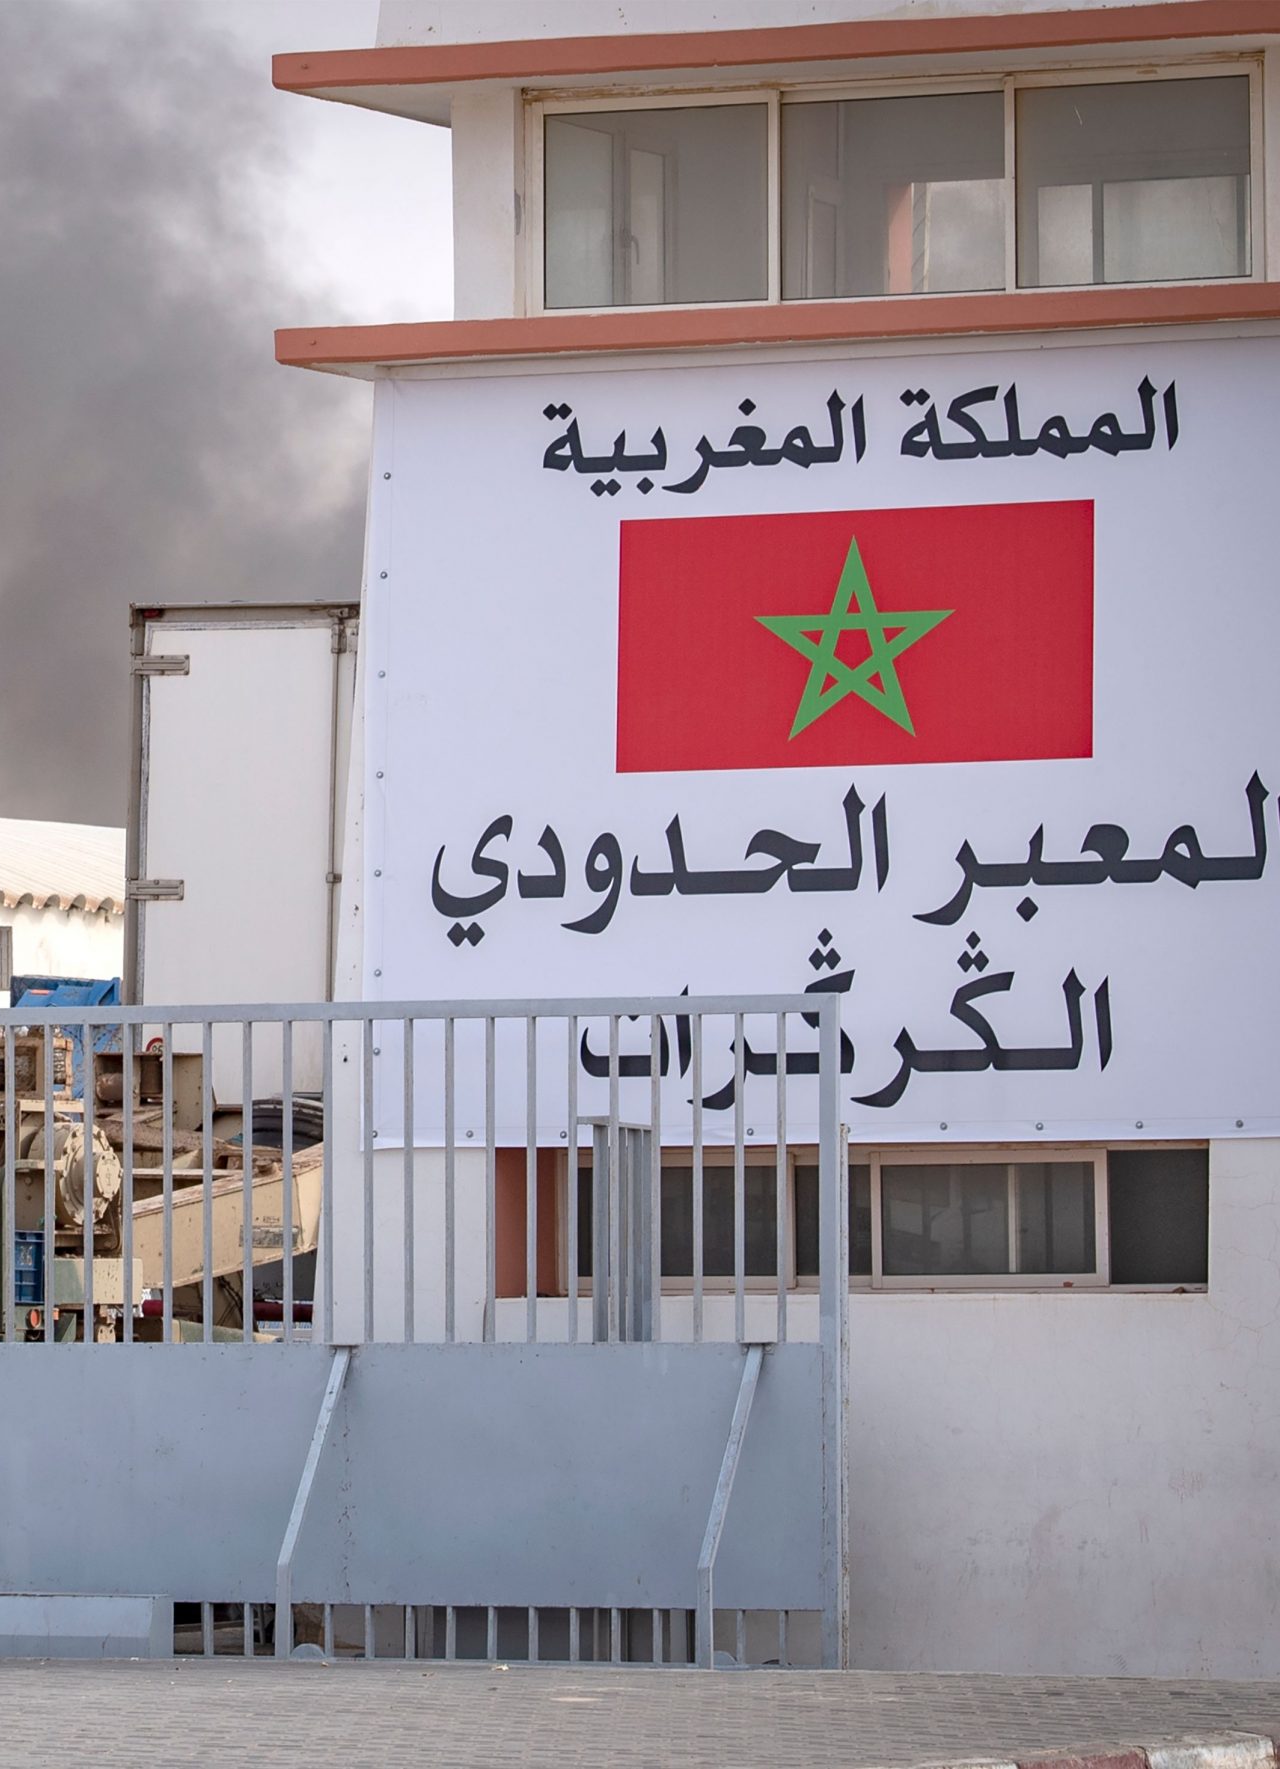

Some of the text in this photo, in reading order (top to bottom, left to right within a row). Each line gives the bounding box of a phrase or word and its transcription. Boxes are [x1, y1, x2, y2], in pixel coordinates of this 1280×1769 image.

[541, 374, 1180, 498] المملكة المغربية
[430, 769, 1280, 948] لمعبر الحدودي
